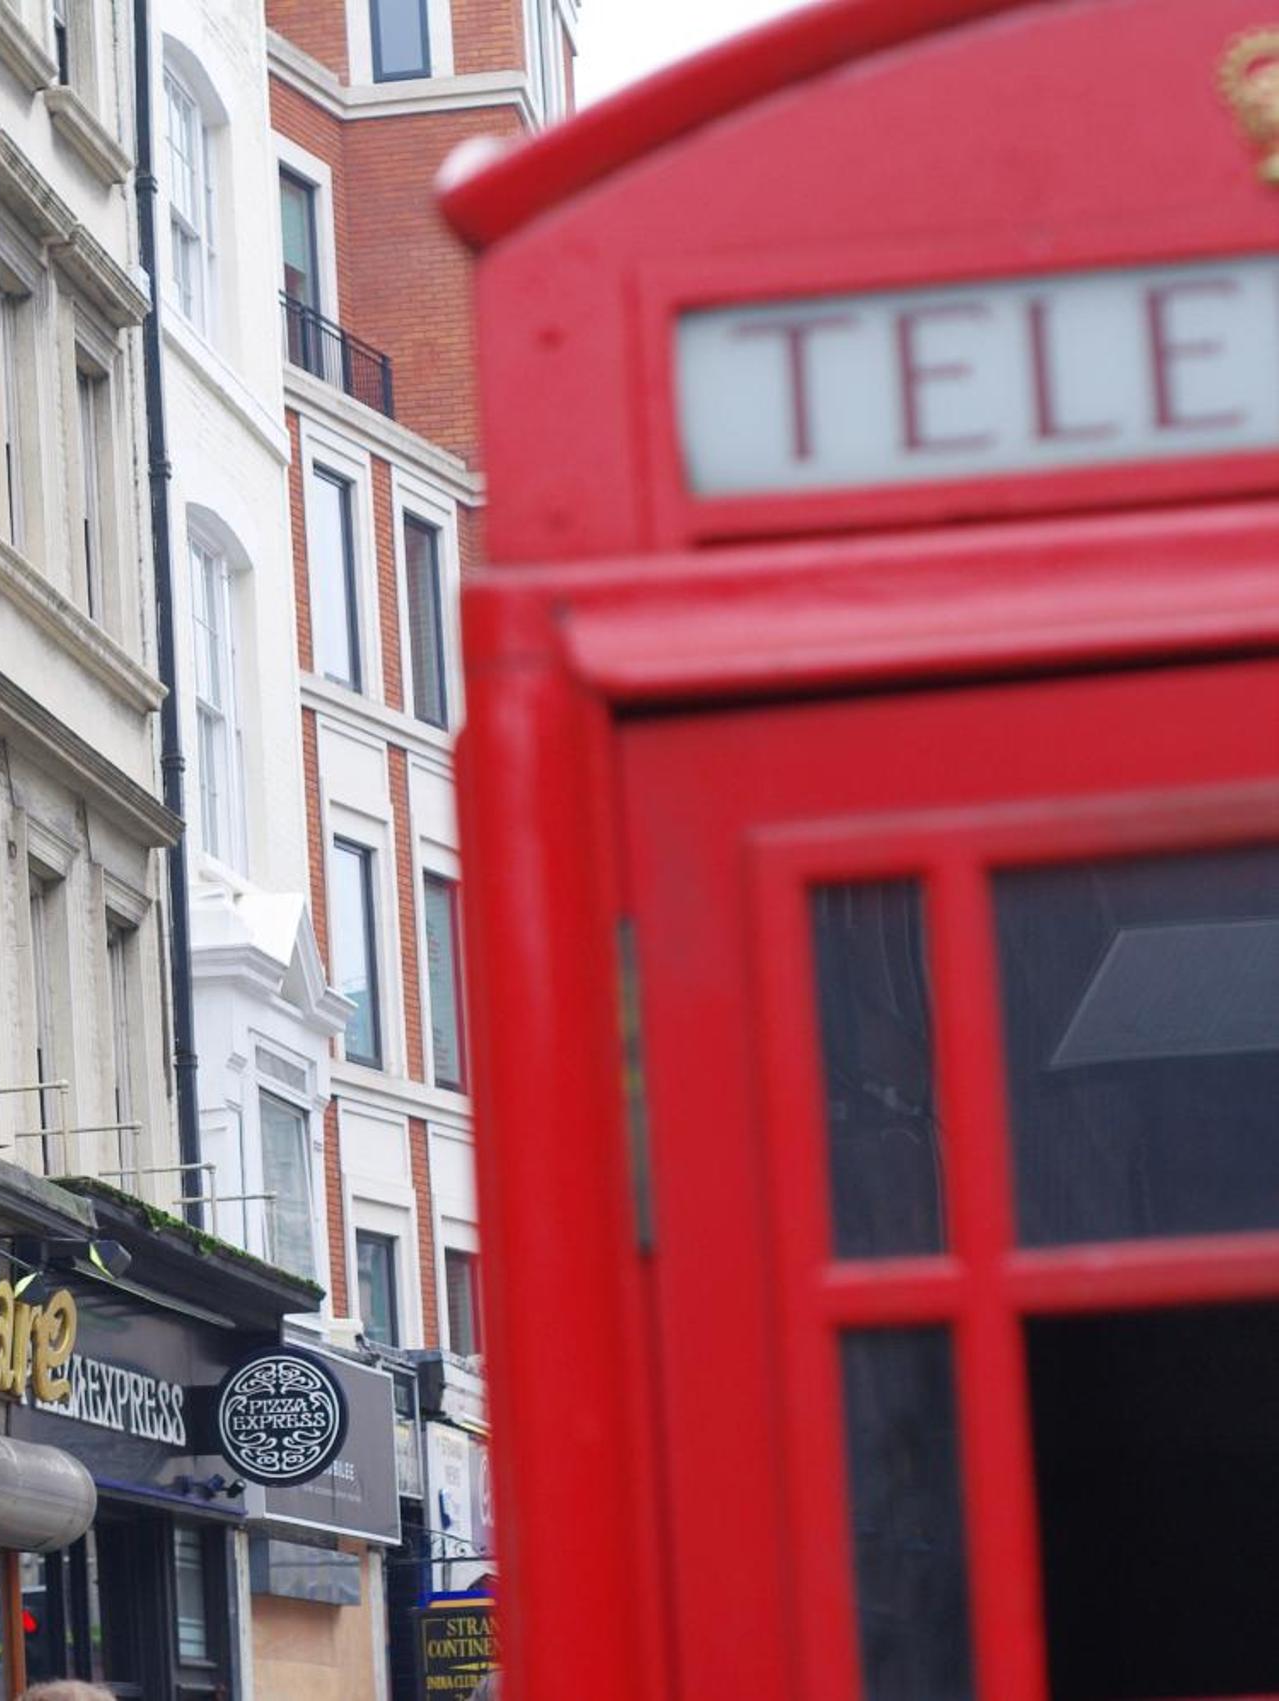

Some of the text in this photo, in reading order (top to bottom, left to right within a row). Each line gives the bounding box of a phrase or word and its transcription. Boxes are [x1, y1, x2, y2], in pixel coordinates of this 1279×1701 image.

[731, 276, 1279, 462] TELE
[249, 1398, 308, 1414] PIZZA
[233, 1412, 326, 1430] EXPRESS
